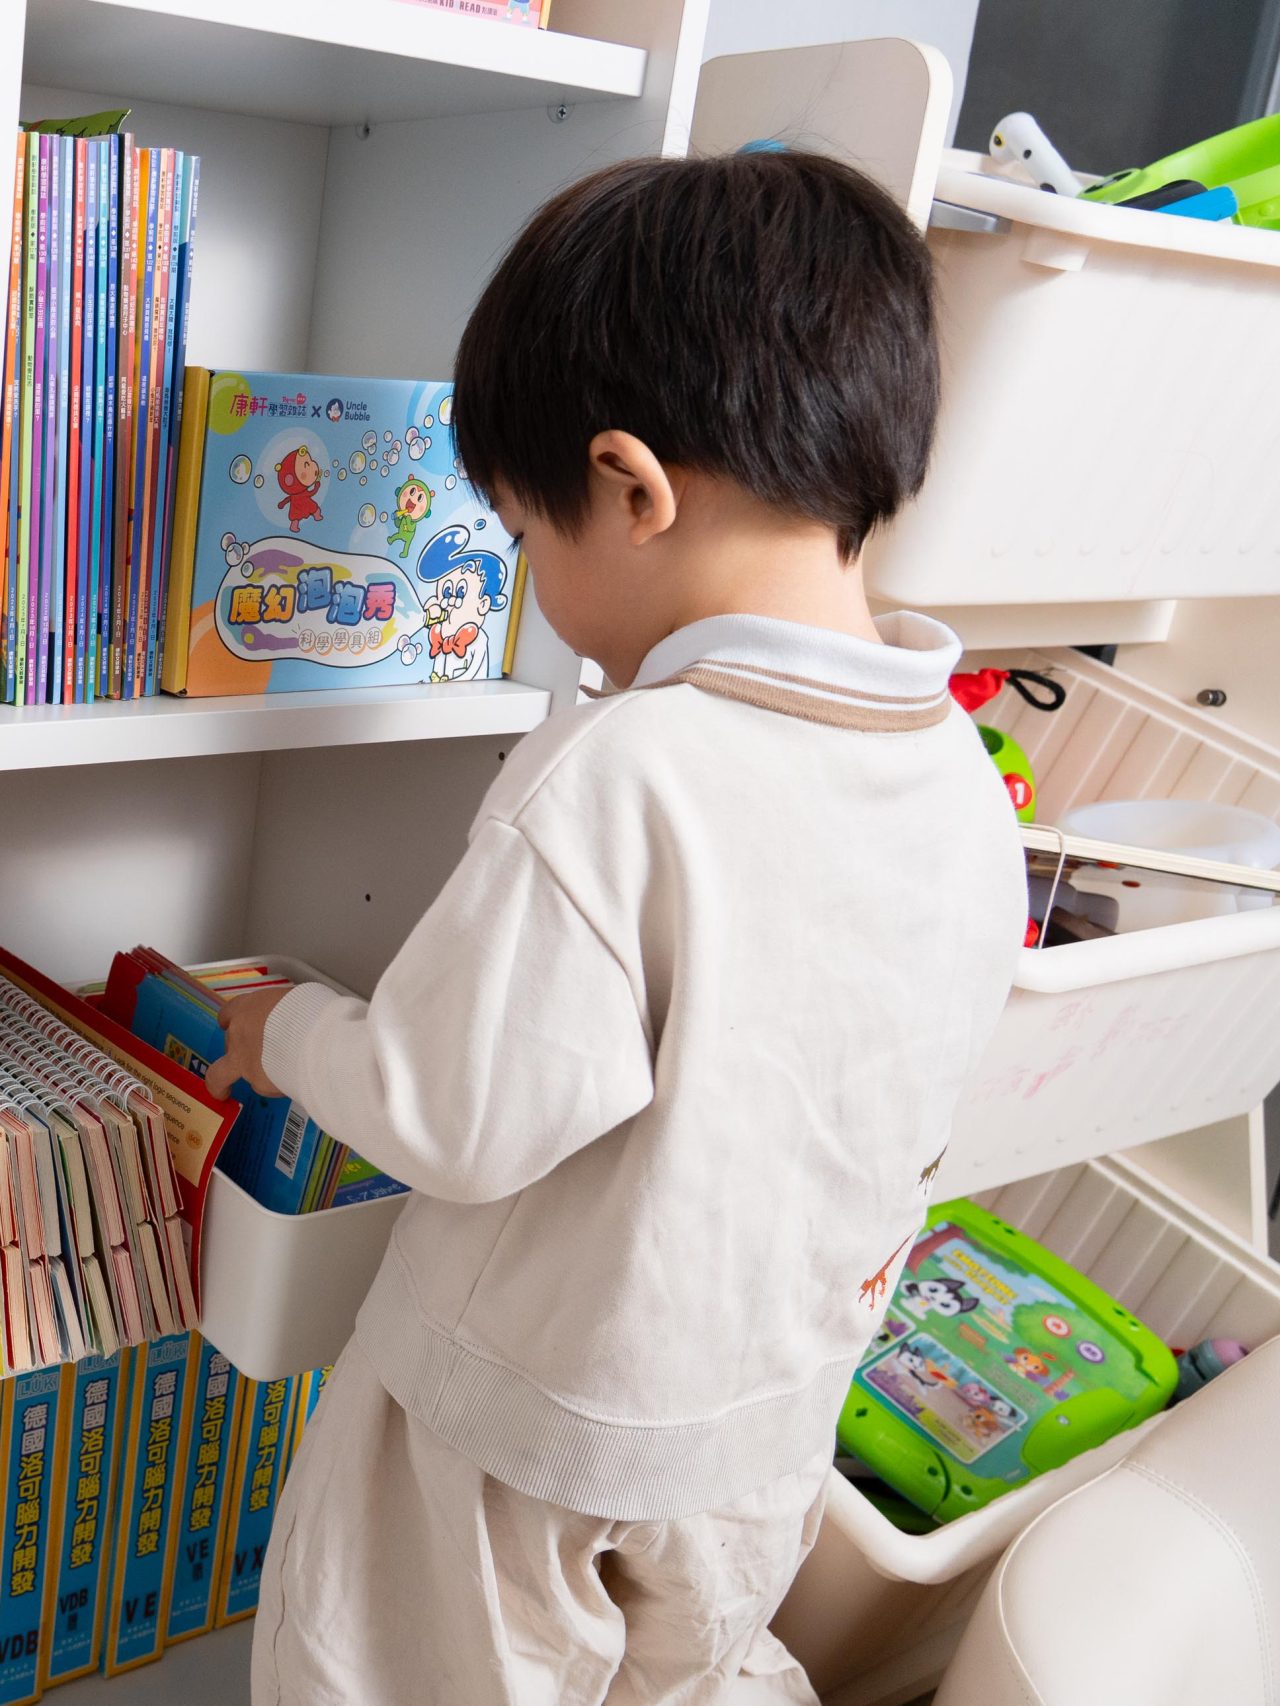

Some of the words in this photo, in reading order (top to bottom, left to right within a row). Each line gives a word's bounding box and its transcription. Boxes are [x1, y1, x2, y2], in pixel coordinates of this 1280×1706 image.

[459, 2, 481, 13] READ
[344, 412, 371, 422] Bubble
[346, 401, 368, 411] Uncle
[227, 565, 396, 626] 魔幻泡泡秀
[297, 629, 382, 654] 科學學具組
[152, 1080, 167, 1098] logic
[165, 1092, 193, 1115] sequence
[148, 1340, 190, 1368] LÜK
[17, 1372, 60, 1401] LÜK
[188, 1352, 230, 1533] 德國洛可腦力開發
[70, 1378, 110, 1569] 德國洛可腦力開發
[136, 1370, 178, 1557] 德國洛可腦力開發
[10, 1403, 48, 1597] 德國洛可腦力開發
[58, 1587, 89, 1616] VDB
